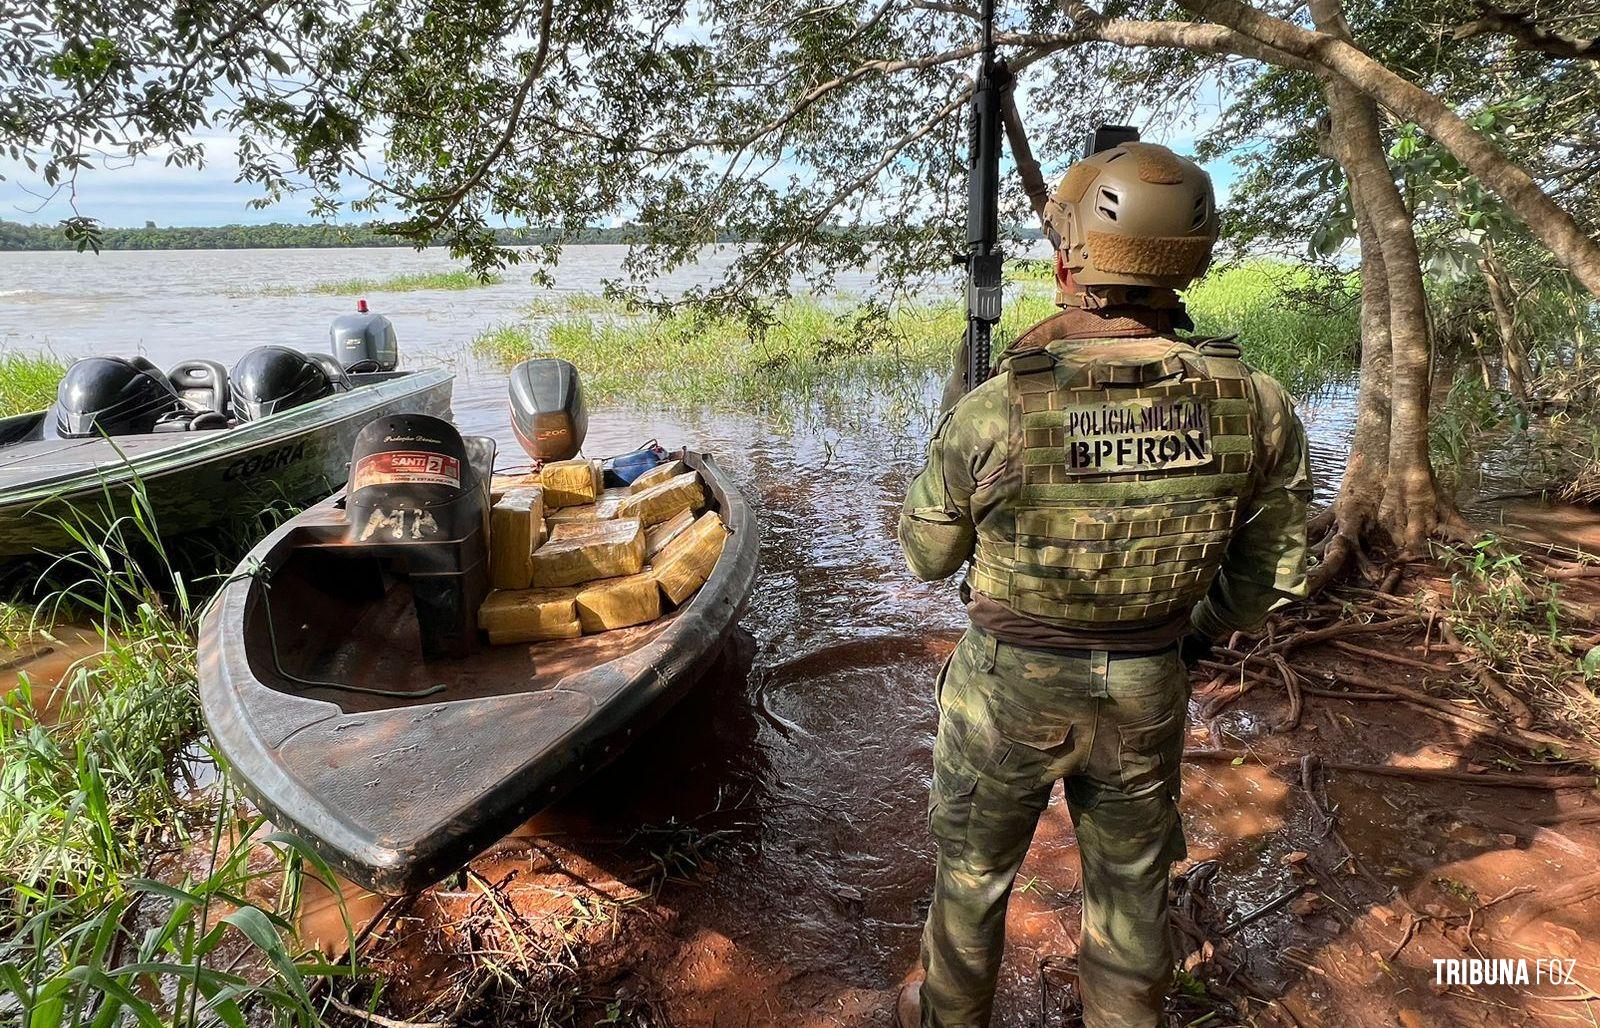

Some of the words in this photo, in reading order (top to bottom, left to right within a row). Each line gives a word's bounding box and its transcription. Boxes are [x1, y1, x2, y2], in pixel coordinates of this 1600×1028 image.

[1069, 404, 1136, 437] POLÍCIA
[1140, 402, 1204, 433] MILITAR
[222, 440, 306, 481] COBRA
[391, 457, 426, 467] SANTI
[429, 460, 440, 472] 2
[1070, 431, 1206, 469] BPFRON
